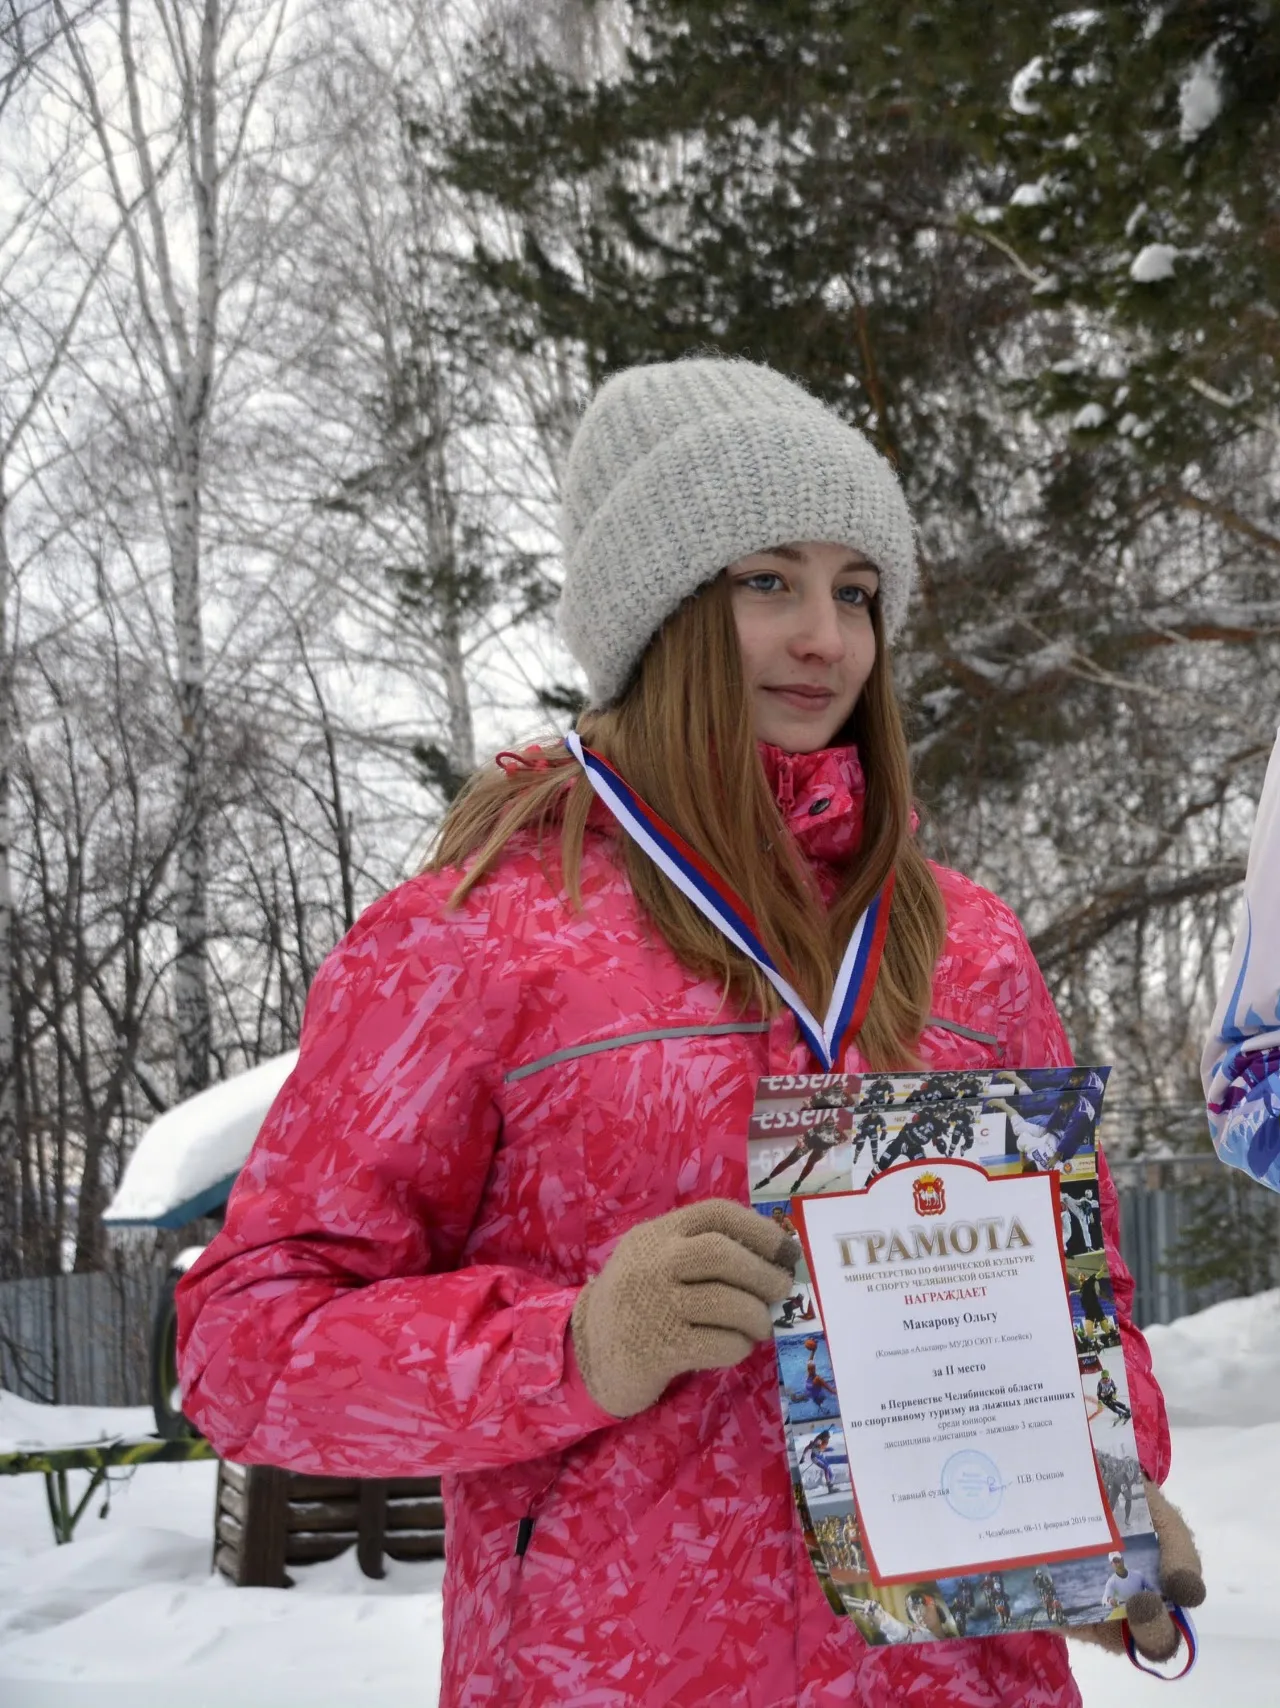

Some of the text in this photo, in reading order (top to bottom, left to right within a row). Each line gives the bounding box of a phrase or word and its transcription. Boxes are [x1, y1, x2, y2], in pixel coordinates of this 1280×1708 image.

[833, 1216, 1034, 1267] ГРАМОТА
[844, 1255, 1035, 1283] МИНИСТЕРСТВО ПО ФИЗИЧЕСКОЙ КУЛЬТУРЕ
[867, 1269, 1018, 1292] И СПОРТУ ЧЕЛЯБИНСКОЙ ОБЛАСТИ
[904, 1286, 987, 1304] НАГРАЖДАЕТ
[903, 1312, 997, 1330] Макарову Ольгу
[949, 1339, 973, 1348] МУДО
[974, 1336, 993, 1345] СЮТ
[933, 1363, 986, 1377] за II место
[888, 1396, 942, 1410] Первенстве
[944, 1385, 1006, 1401] Челябинской
[1008, 1382, 1044, 1393] области
[851, 1391, 1076, 1428] по спортивному туризму на лыжных дистанциях
[938, 1415, 996, 1430] среди юниорок
[884, 1436, 930, 1449] дисциплина
[986, 1425, 1019, 1435] лыжная»
[1021, 1421, 1026, 1429] 3
[1028, 1420, 1053, 1428] класса
[1036, 1471, 1064, 1481] Осипов
[1071, 1516, 1087, 1525] 2019
